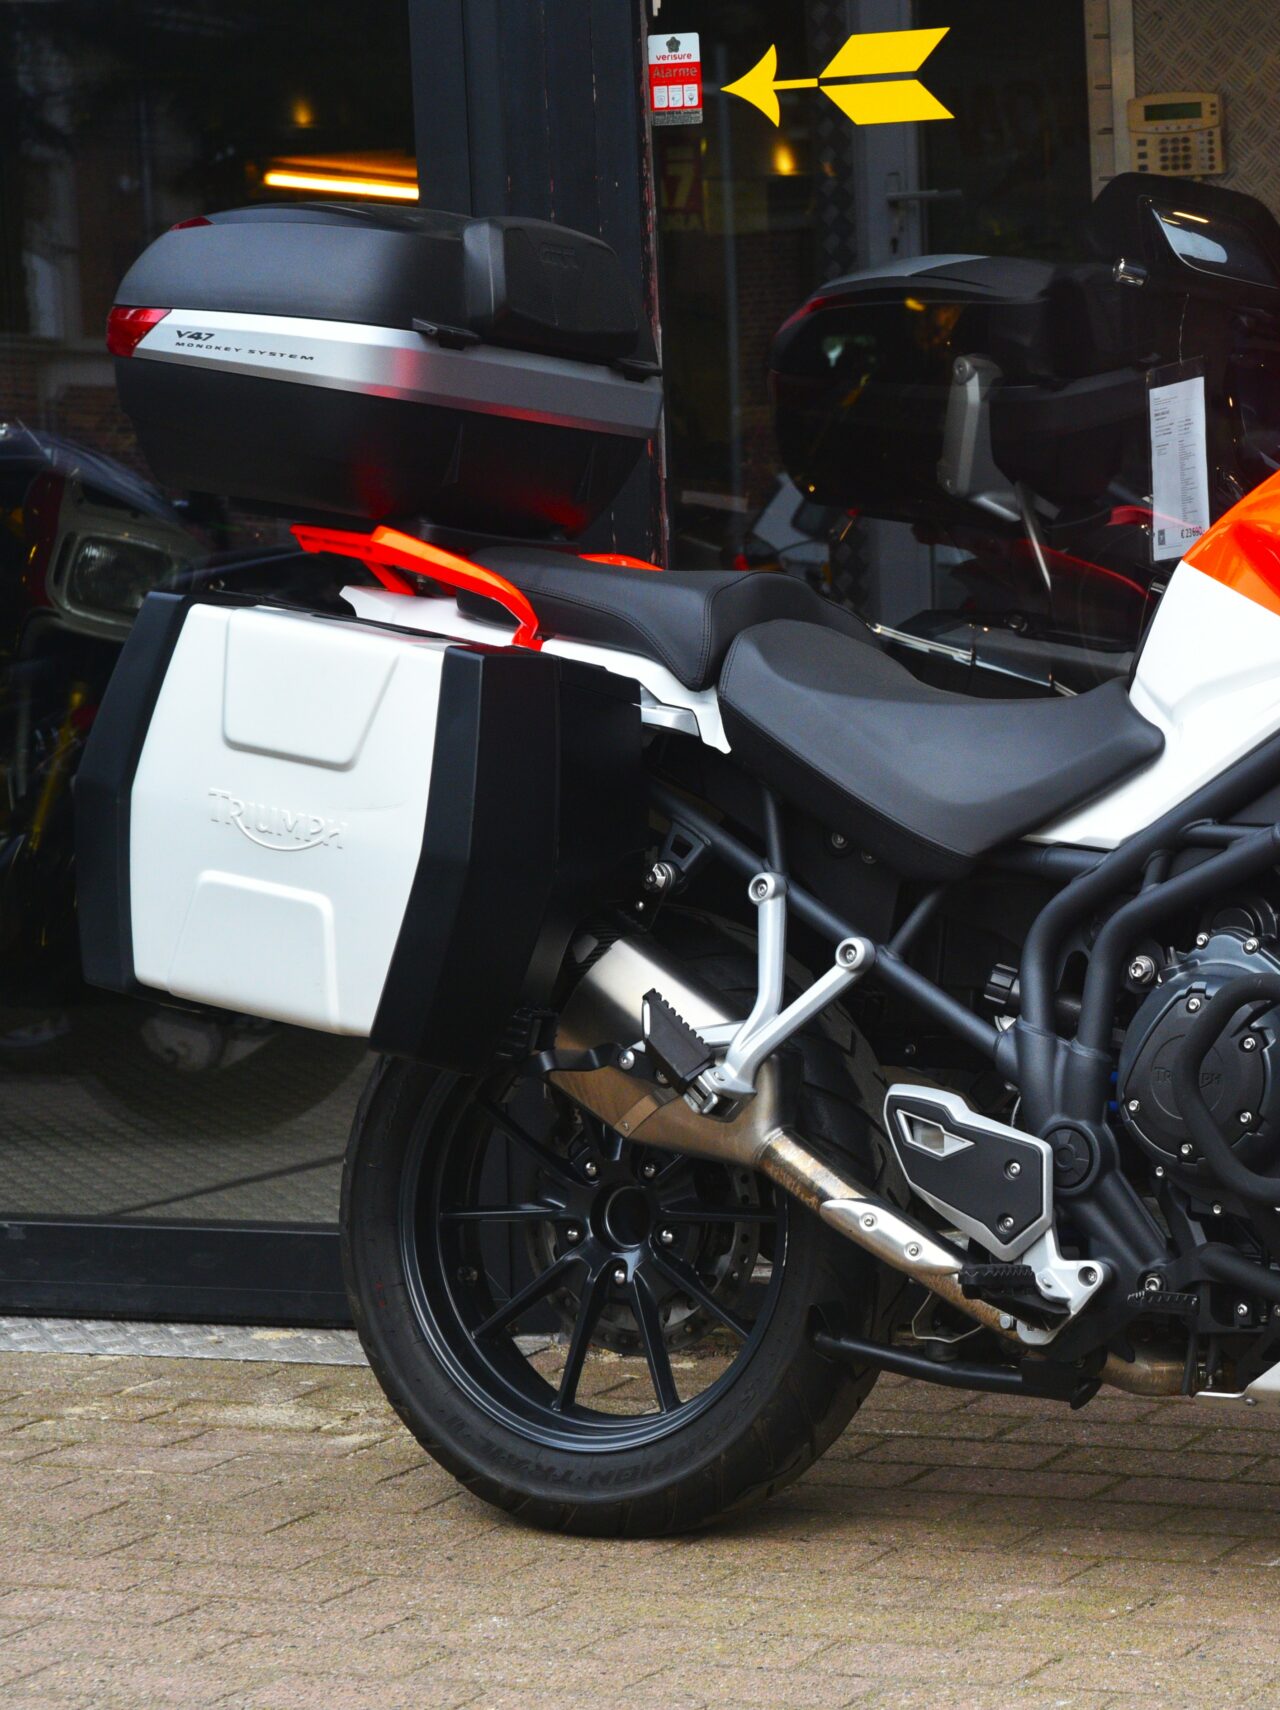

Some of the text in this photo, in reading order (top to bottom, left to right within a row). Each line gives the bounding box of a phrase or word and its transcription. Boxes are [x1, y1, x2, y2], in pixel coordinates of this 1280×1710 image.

[656, 52, 693, 61] verisure
[652, 66, 698, 79] Alarme
[176, 330, 215, 341] V47
[174, 341, 315, 361] MONOKEY SYSTEM
[207, 786, 349, 851] TRIUMPH
